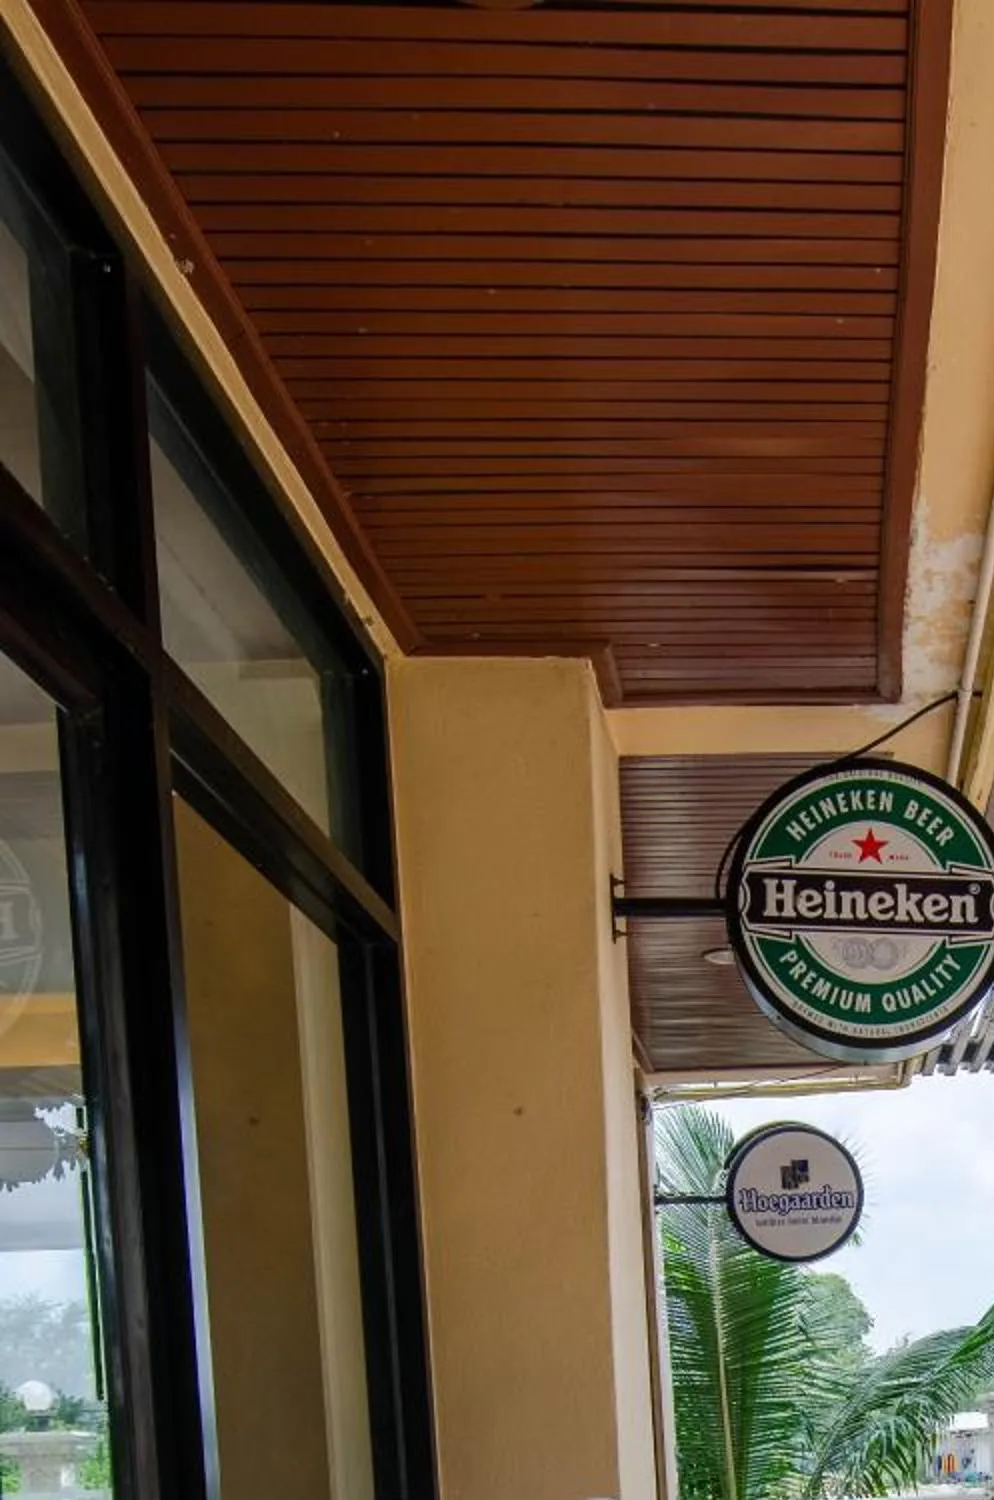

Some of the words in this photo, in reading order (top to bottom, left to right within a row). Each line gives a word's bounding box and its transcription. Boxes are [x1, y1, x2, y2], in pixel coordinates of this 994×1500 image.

[785, 788, 894, 842] HEINEKEN
[903, 799, 956, 847] BEER
[762, 878, 980, 924] Heineken
[779, 950, 871, 1013] PREMIUM
[881, 954, 962, 1013] QUALITY
[738, 1184, 855, 1216] Hoegaarden
